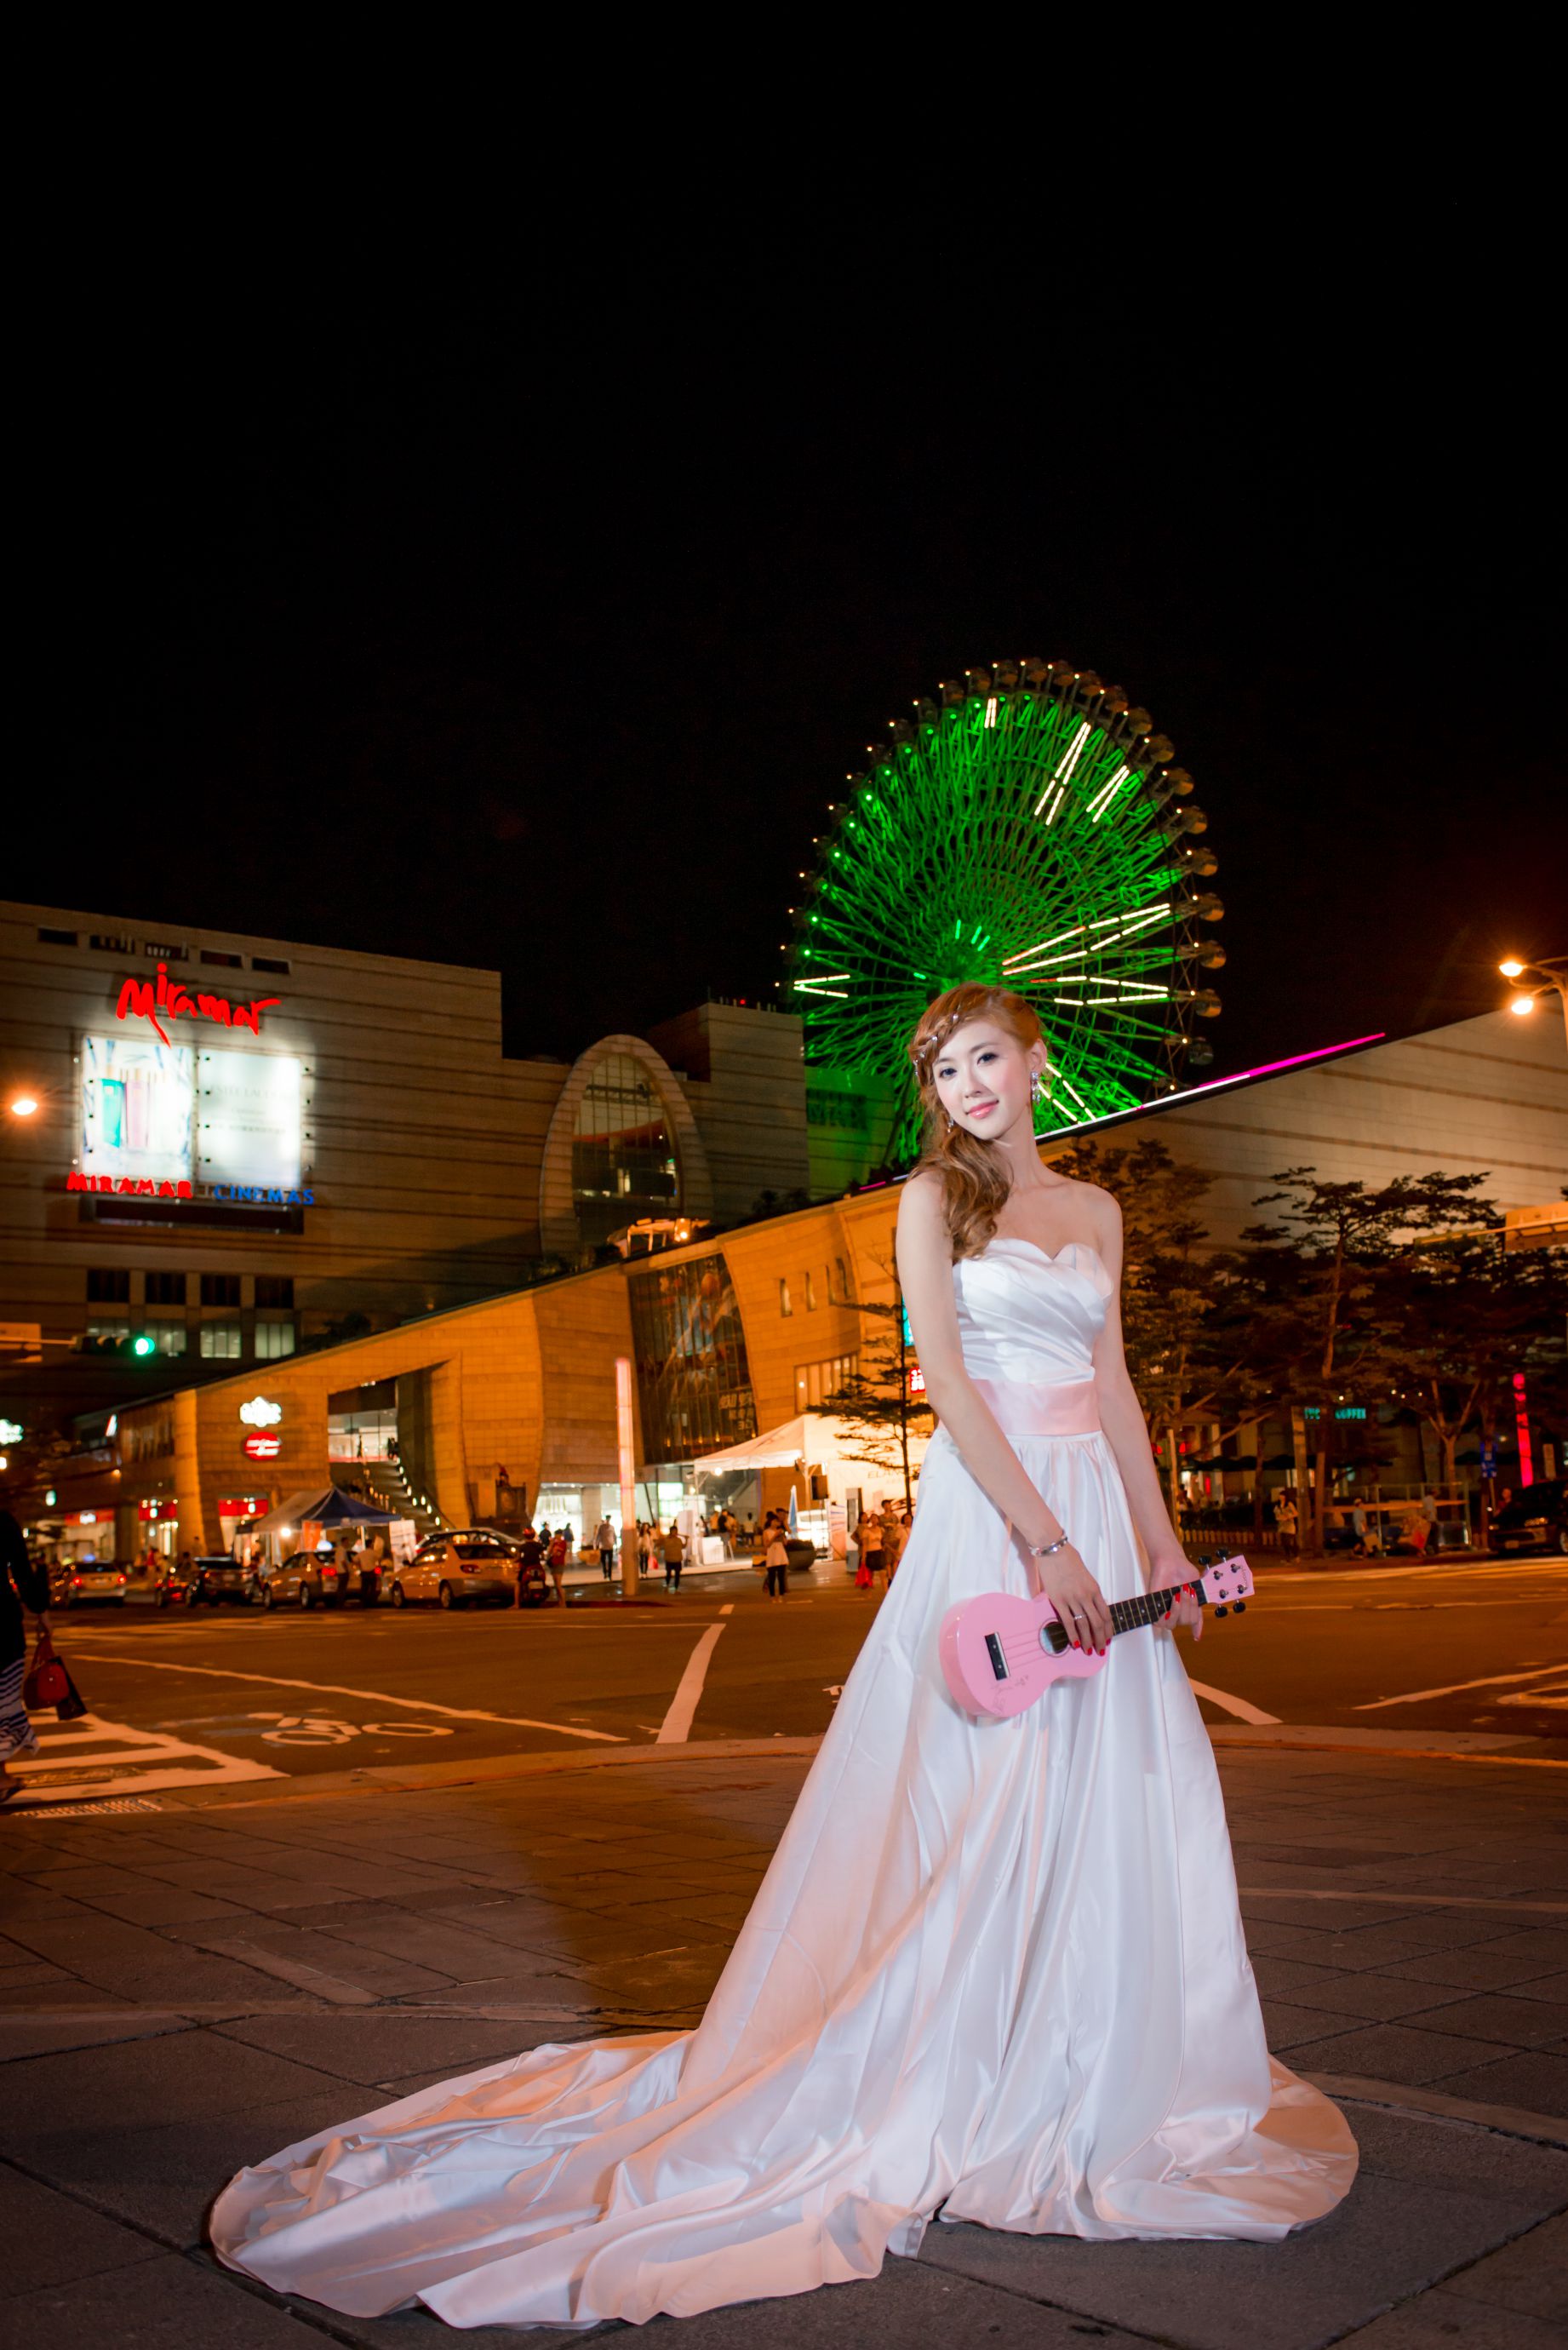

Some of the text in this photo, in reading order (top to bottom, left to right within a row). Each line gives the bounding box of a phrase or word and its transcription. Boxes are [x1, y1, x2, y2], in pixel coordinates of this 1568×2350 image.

[116, 962, 282, 1050] Miramar
[66, 1172, 315, 1205] MIRAMAR CINEMAS
